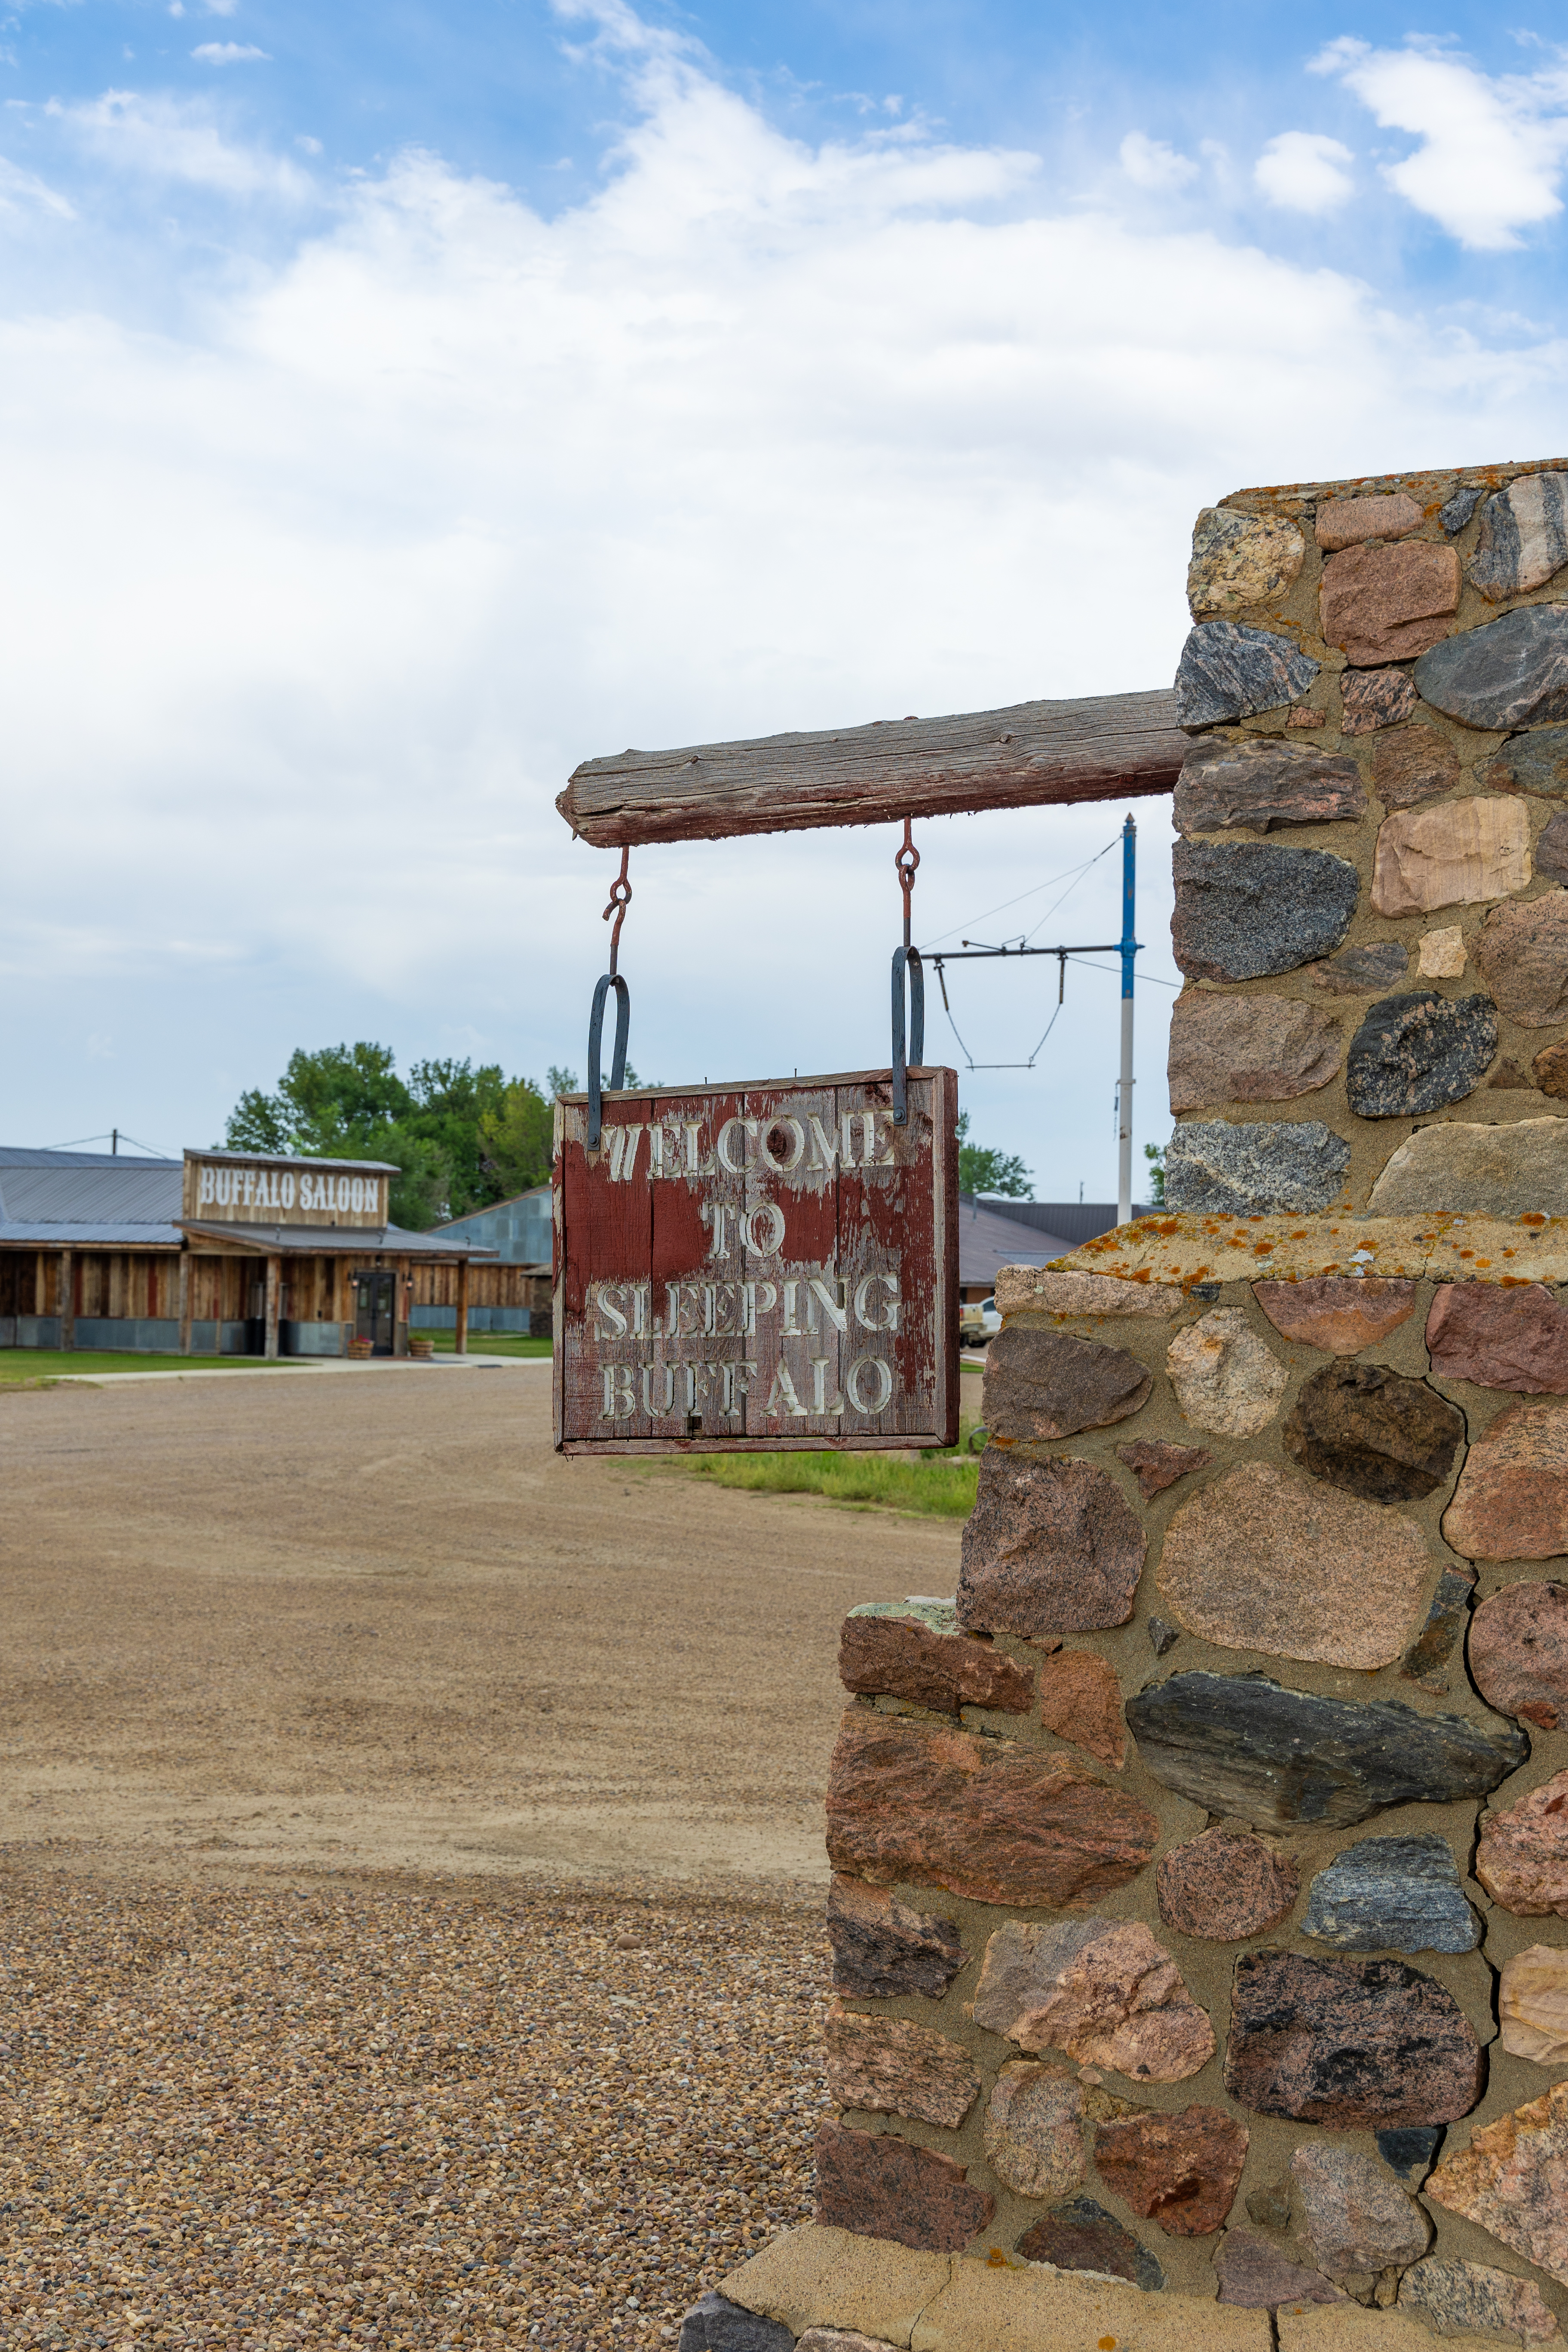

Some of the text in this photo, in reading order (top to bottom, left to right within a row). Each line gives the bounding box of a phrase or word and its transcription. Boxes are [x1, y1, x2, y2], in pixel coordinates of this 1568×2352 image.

[602, 1109, 894, 1182] WELCOME
[200, 1167, 379, 1213] BUFFALO SALOON
[702, 1202, 785, 1259] TO
[595, 1273, 901, 1341] SLEEPING
[600, 1356, 892, 1420] BUFFALO
